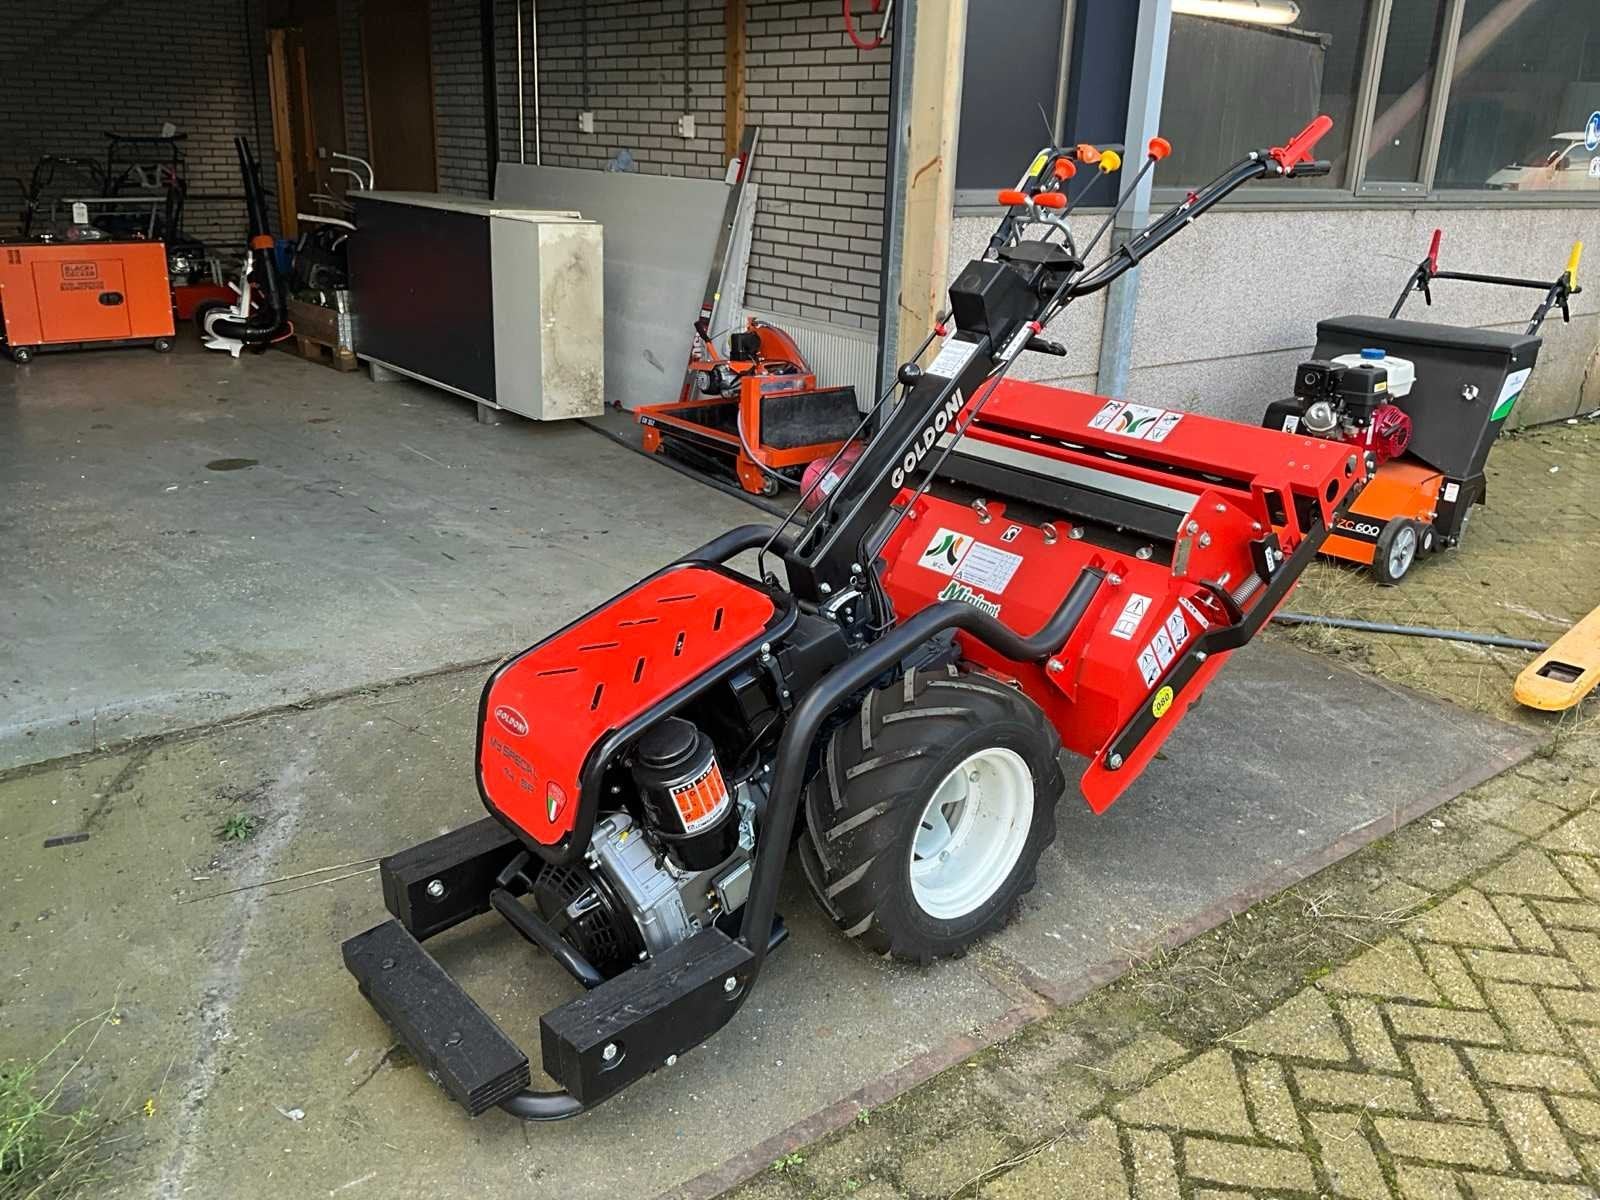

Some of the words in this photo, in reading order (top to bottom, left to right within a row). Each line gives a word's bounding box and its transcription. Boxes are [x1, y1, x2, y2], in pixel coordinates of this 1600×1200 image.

[891, 388, 964, 489] GOLDONI
[1355, 523, 1380, 536] 600
[1156, 693, 1170, 711] 080
[496, 708, 527, 733] GOLDONI
